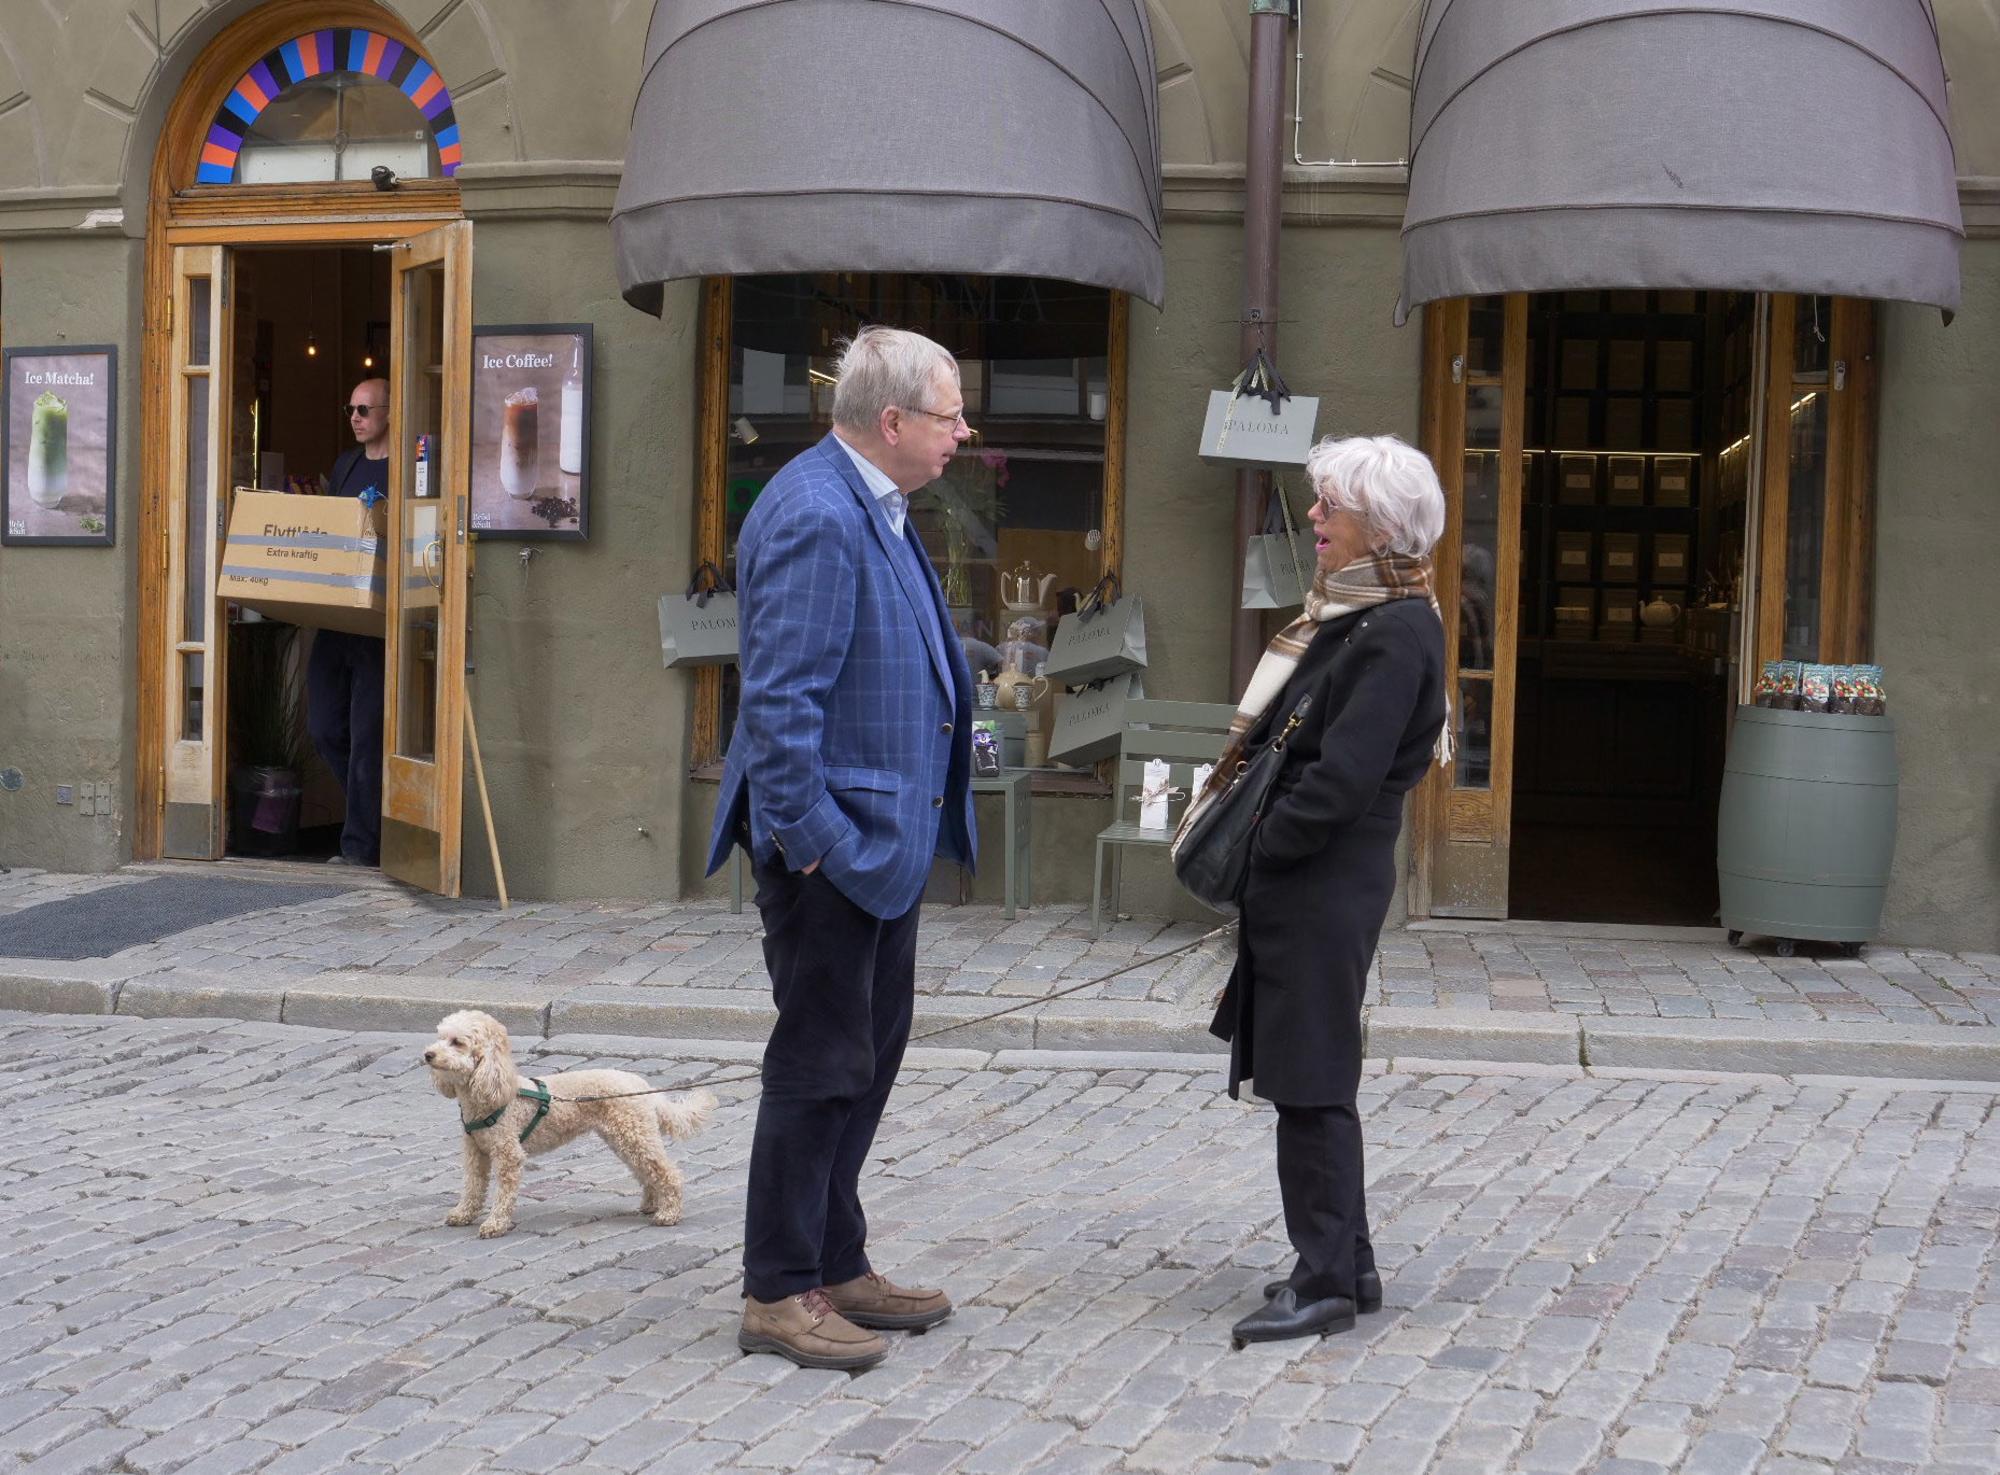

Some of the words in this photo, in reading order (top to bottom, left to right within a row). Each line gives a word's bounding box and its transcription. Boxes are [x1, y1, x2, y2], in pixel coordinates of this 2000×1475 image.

[482, 354, 503, 369] Ice
[505, 353, 553, 369] Coffee!
[24, 371, 43, 385] Ice
[44, 372, 94, 386] Matcha!
[1228, 419, 1289, 435] PALOMA
[266, 547, 289, 557] Extra
[291, 548, 319, 561] kraftig
[691, 616, 736, 631] PALOM
